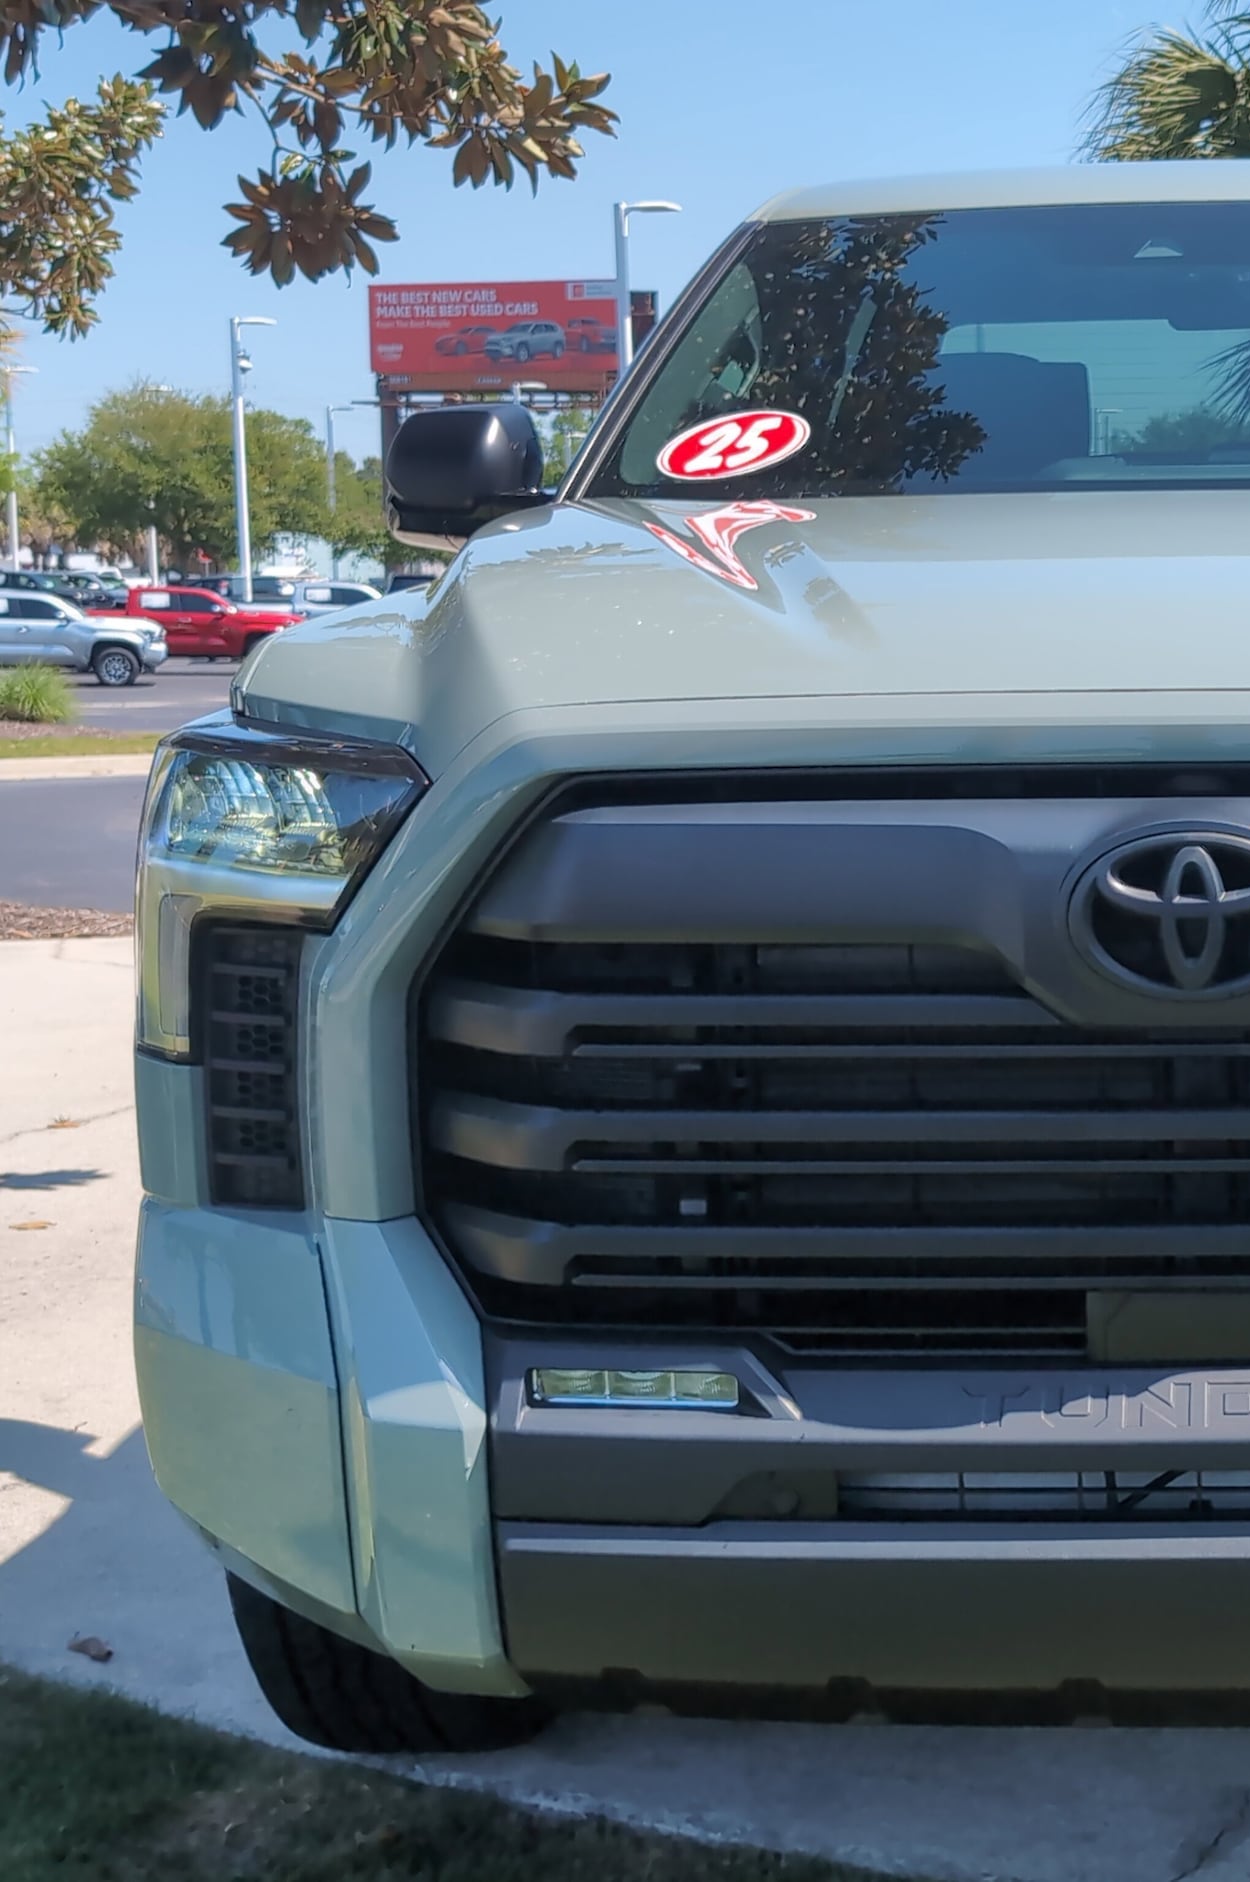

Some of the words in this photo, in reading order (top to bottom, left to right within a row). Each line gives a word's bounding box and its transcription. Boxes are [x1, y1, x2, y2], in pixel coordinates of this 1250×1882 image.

[432, 289, 461, 303] NEW
[376, 305, 411, 318] MAKE
[414, 305, 437, 317] THE
[683, 416, 783, 473] 25
